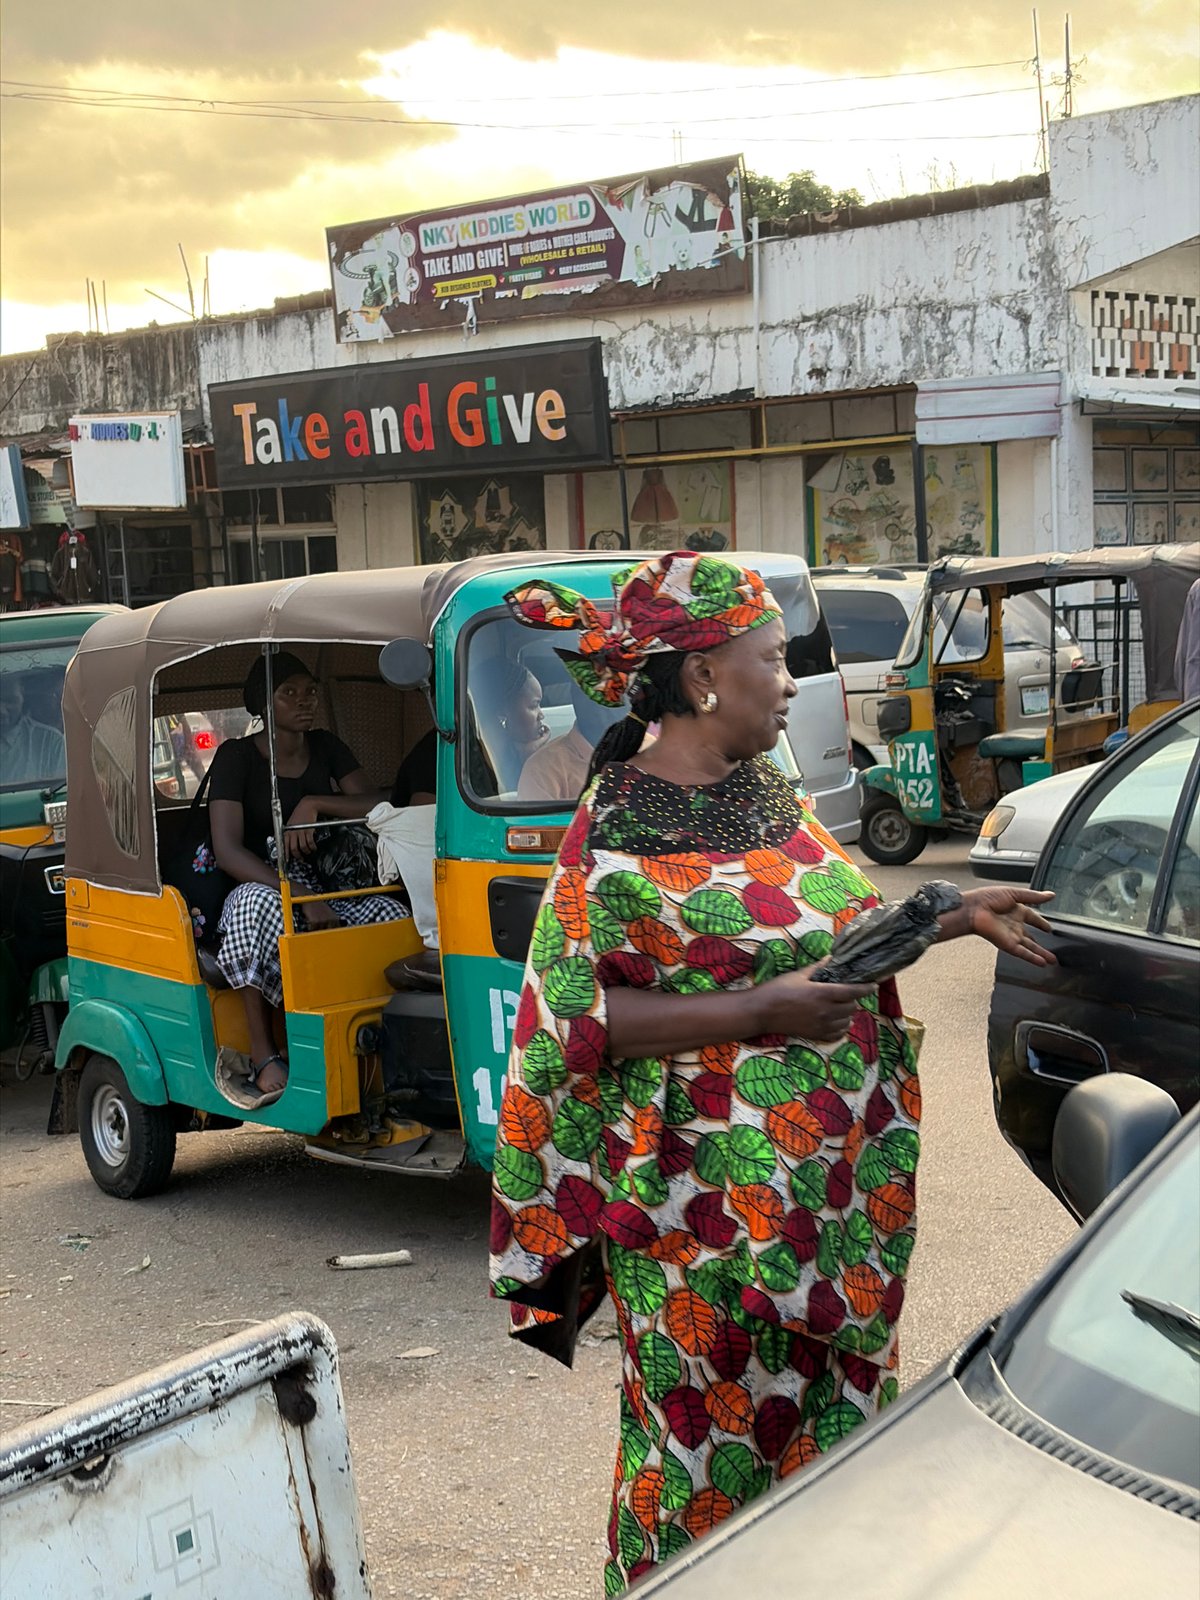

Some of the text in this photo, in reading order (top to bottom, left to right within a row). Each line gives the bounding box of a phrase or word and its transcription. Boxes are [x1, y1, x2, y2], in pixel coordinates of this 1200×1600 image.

[423, 200, 591, 248] NKY KIDDIES WORLD
[422, 247, 504, 278] TAKE AND GIVE
[520, 243, 607, 267] (WHOLESALE & RETAIL)
[233, 376, 567, 466] Take and Give
[472, 1066, 508, 1126] 1
